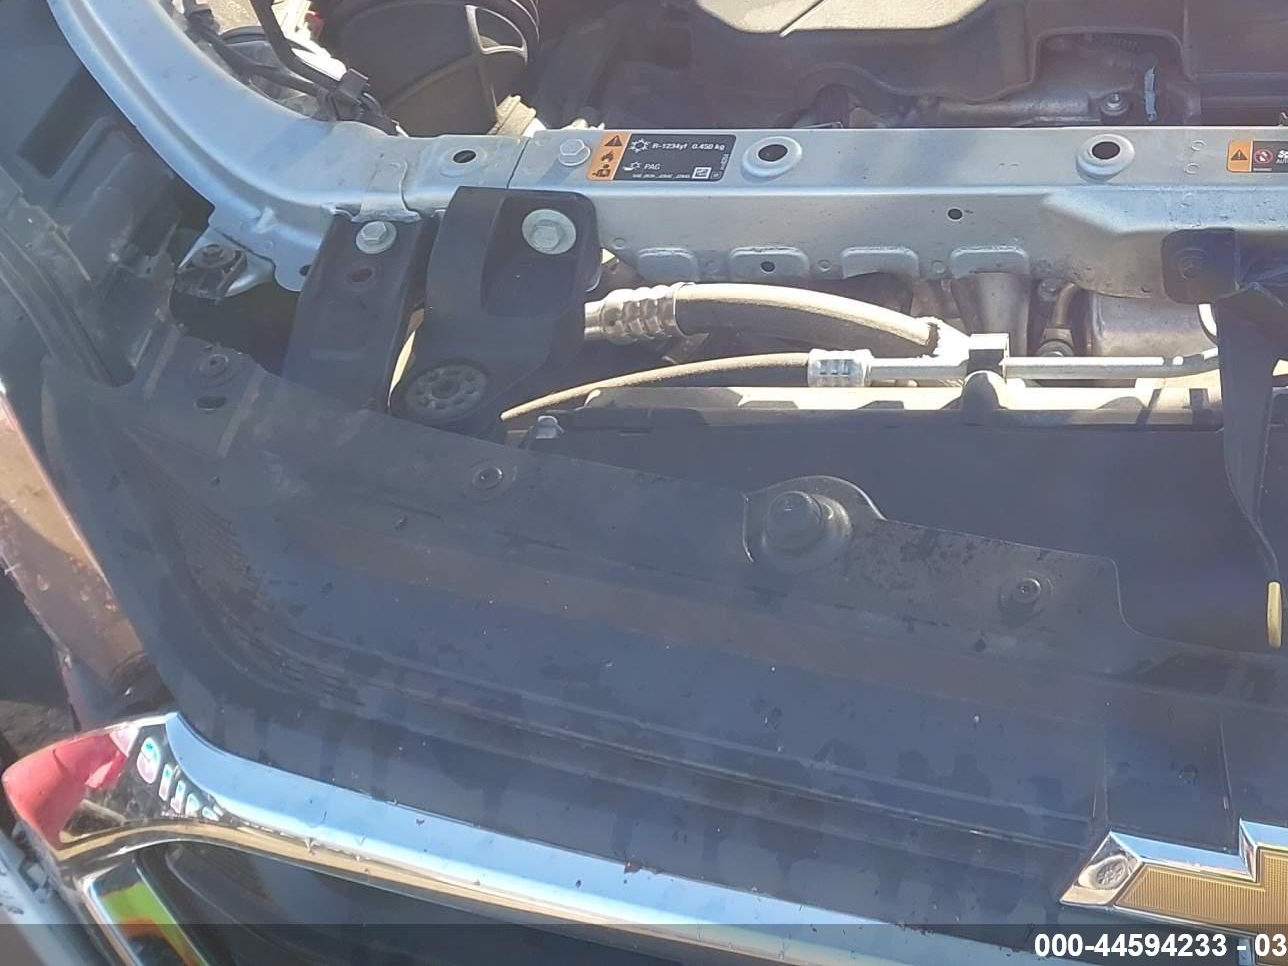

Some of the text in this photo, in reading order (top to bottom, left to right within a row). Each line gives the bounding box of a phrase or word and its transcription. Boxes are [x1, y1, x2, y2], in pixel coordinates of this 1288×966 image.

[651, 142, 689, 152] R-1234yf
[714, 143, 726, 152] kg
[643, 163, 662, 171] PAG
